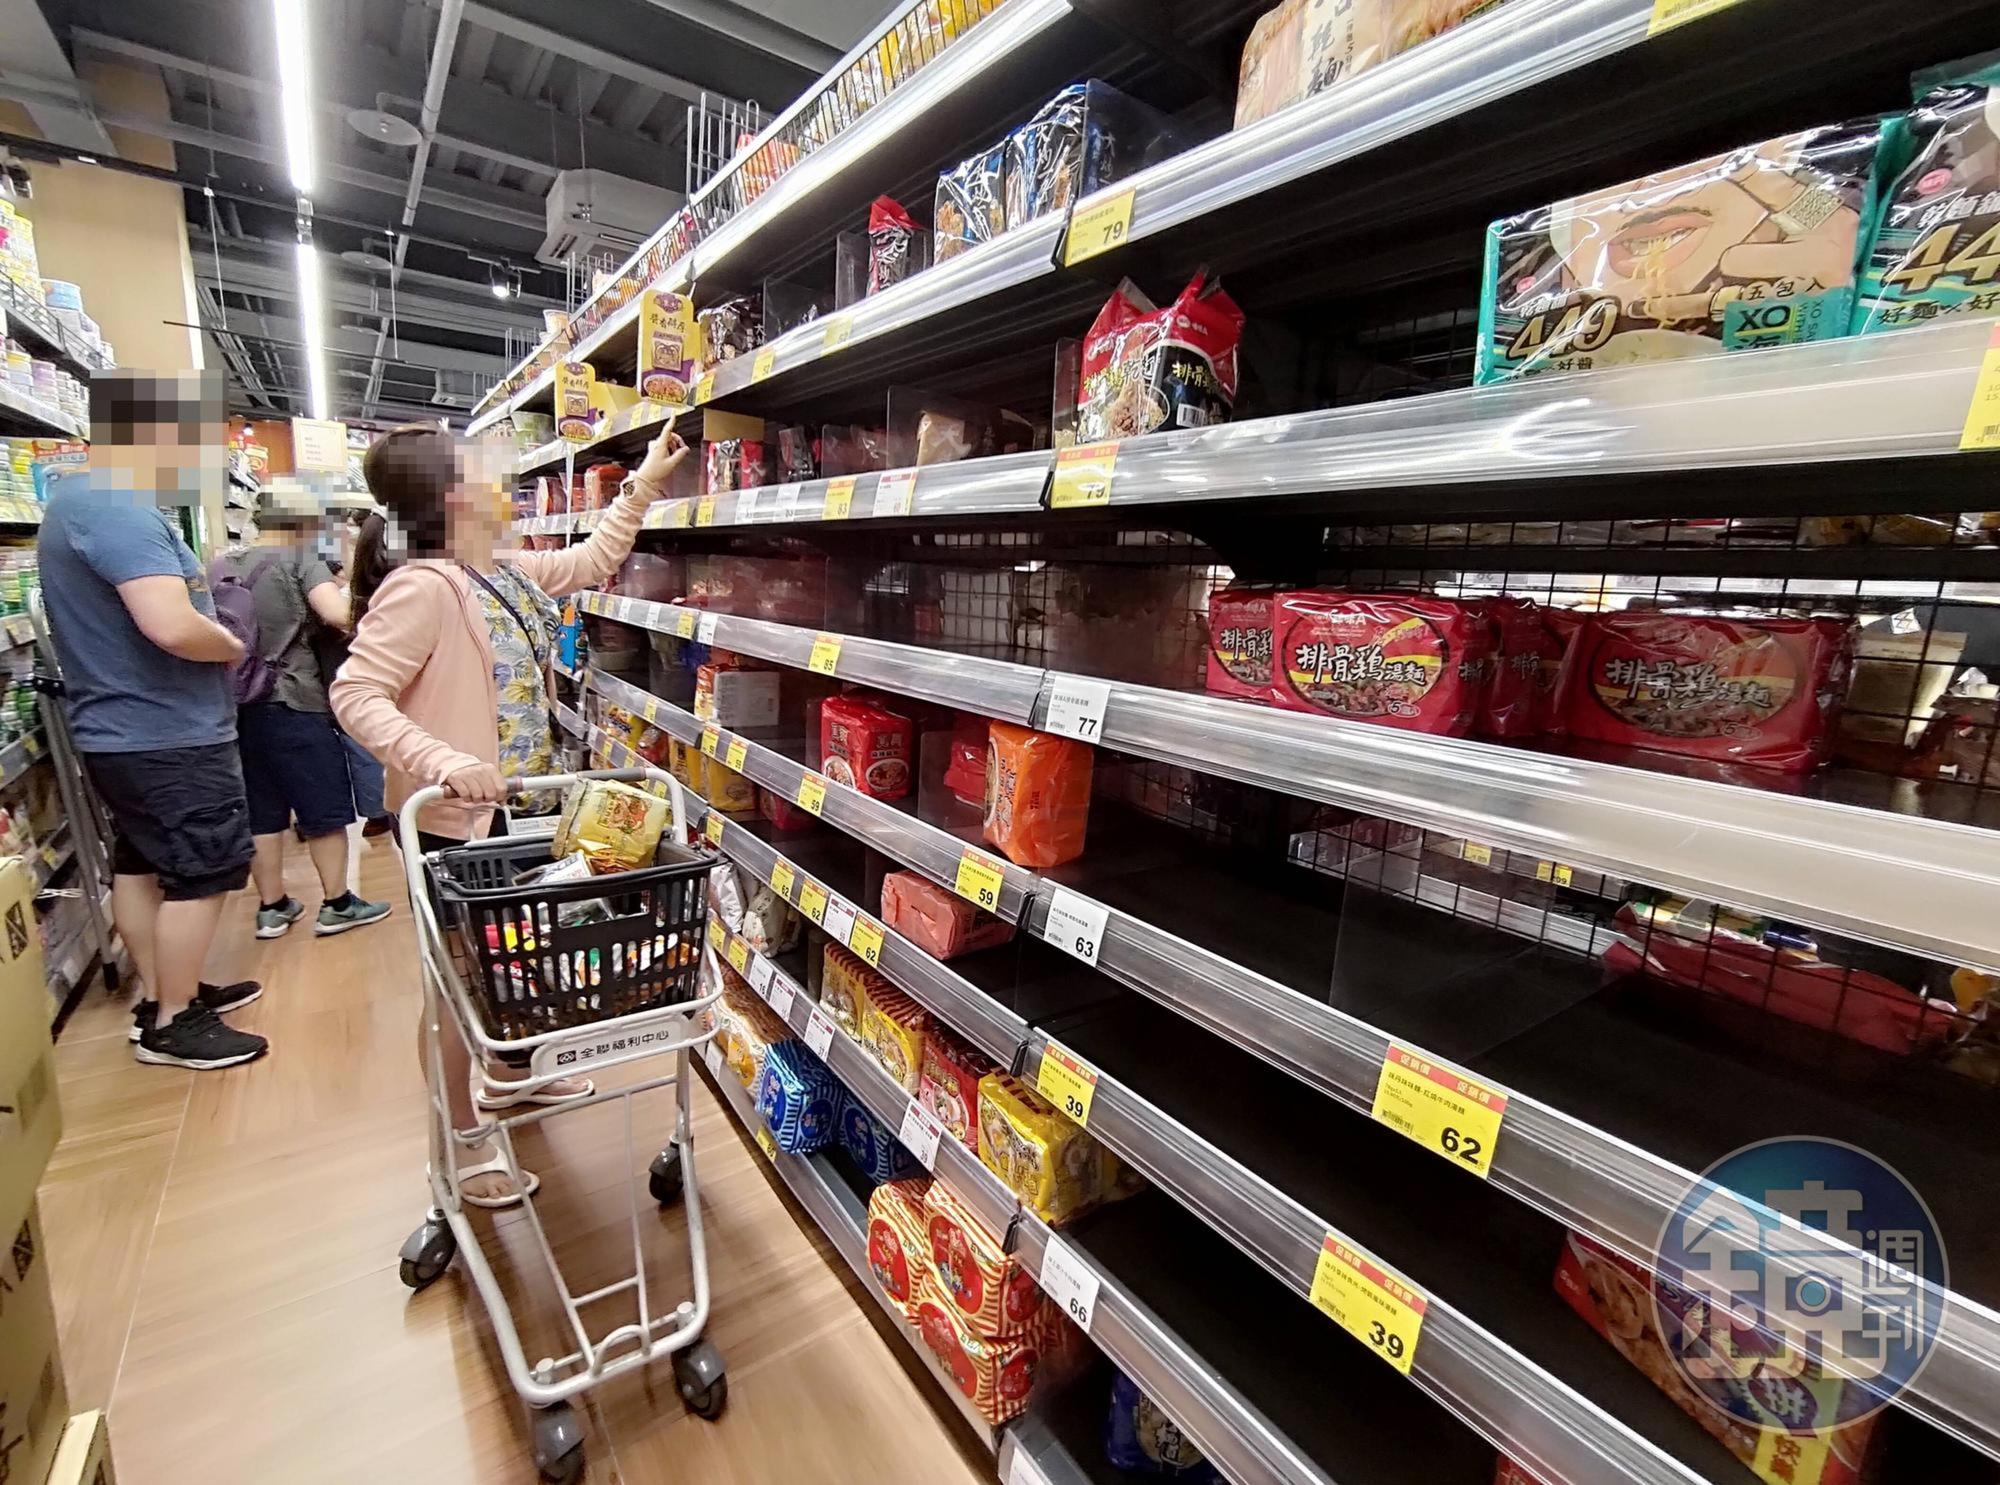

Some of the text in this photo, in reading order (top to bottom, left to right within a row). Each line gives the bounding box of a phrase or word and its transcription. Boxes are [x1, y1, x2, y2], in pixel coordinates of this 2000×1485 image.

[1103, 220, 1123, 244] 79
[1505, 296, 1622, 361] 449
[1736, 304, 1791, 334] XO
[1078, 716, 1097, 735] 77
[811, 799, 820, 812] 59
[781, 885, 790, 897] 62
[979, 888, 994, 905] 59
[811, 907, 821, 921] 62
[865, 947, 876, 962] 62
[1075, 936, 1094, 957] 63
[580, 1030, 669, 1060] 全聯福利中心
[1065, 1095, 1083, 1118] 39
[1441, 1126, 1482, 1165] 62
[1069, 1297, 1088, 1323] 66
[1368, 1320, 1405, 1359] 39
